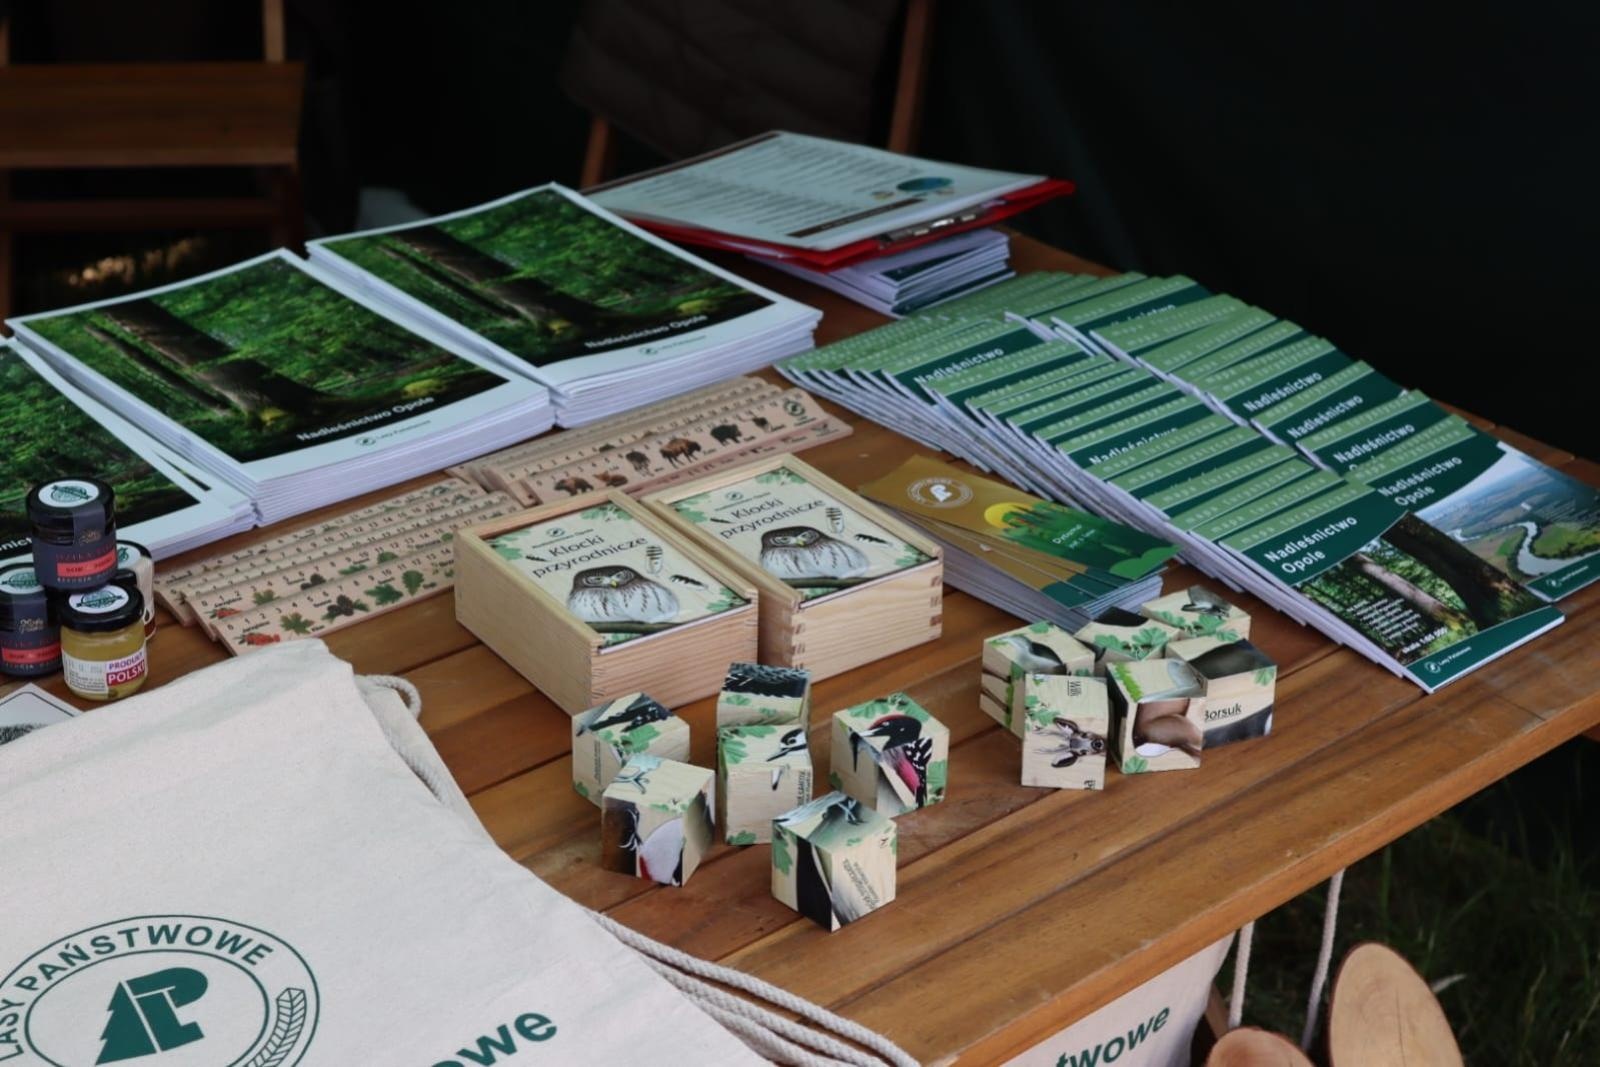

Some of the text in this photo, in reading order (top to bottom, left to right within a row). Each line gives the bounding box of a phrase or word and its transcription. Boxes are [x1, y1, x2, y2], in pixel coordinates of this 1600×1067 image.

[1243, 372, 1323, 411] Nadleśnictwo
[296, 395, 436, 442] Nadleśnictwo Opole
[1287, 395, 1364, 438] Nadleśnictwo
[1333, 424, 1416, 464] Nadleśnictwo
[1377, 456, 1463, 497] Nadleśnictwo
[1394, 485, 1436, 506] Opole
[719, 498, 827, 540] przyrodnicze
[731, 497, 785, 520] Klocki
[532, 536, 650, 579] przyrodnicze
[548, 534, 605, 559] Klocki
[1263, 515, 1358, 563] Nadleśnictwo
[1281, 549, 1326, 574] Opole
[107, 659, 146, 685] POLSKI
[108, 651, 144, 671] PRODUKT
[15, 924, 274, 992] PAŃSTWOWE
[431, 1012, 558, 1067] we
